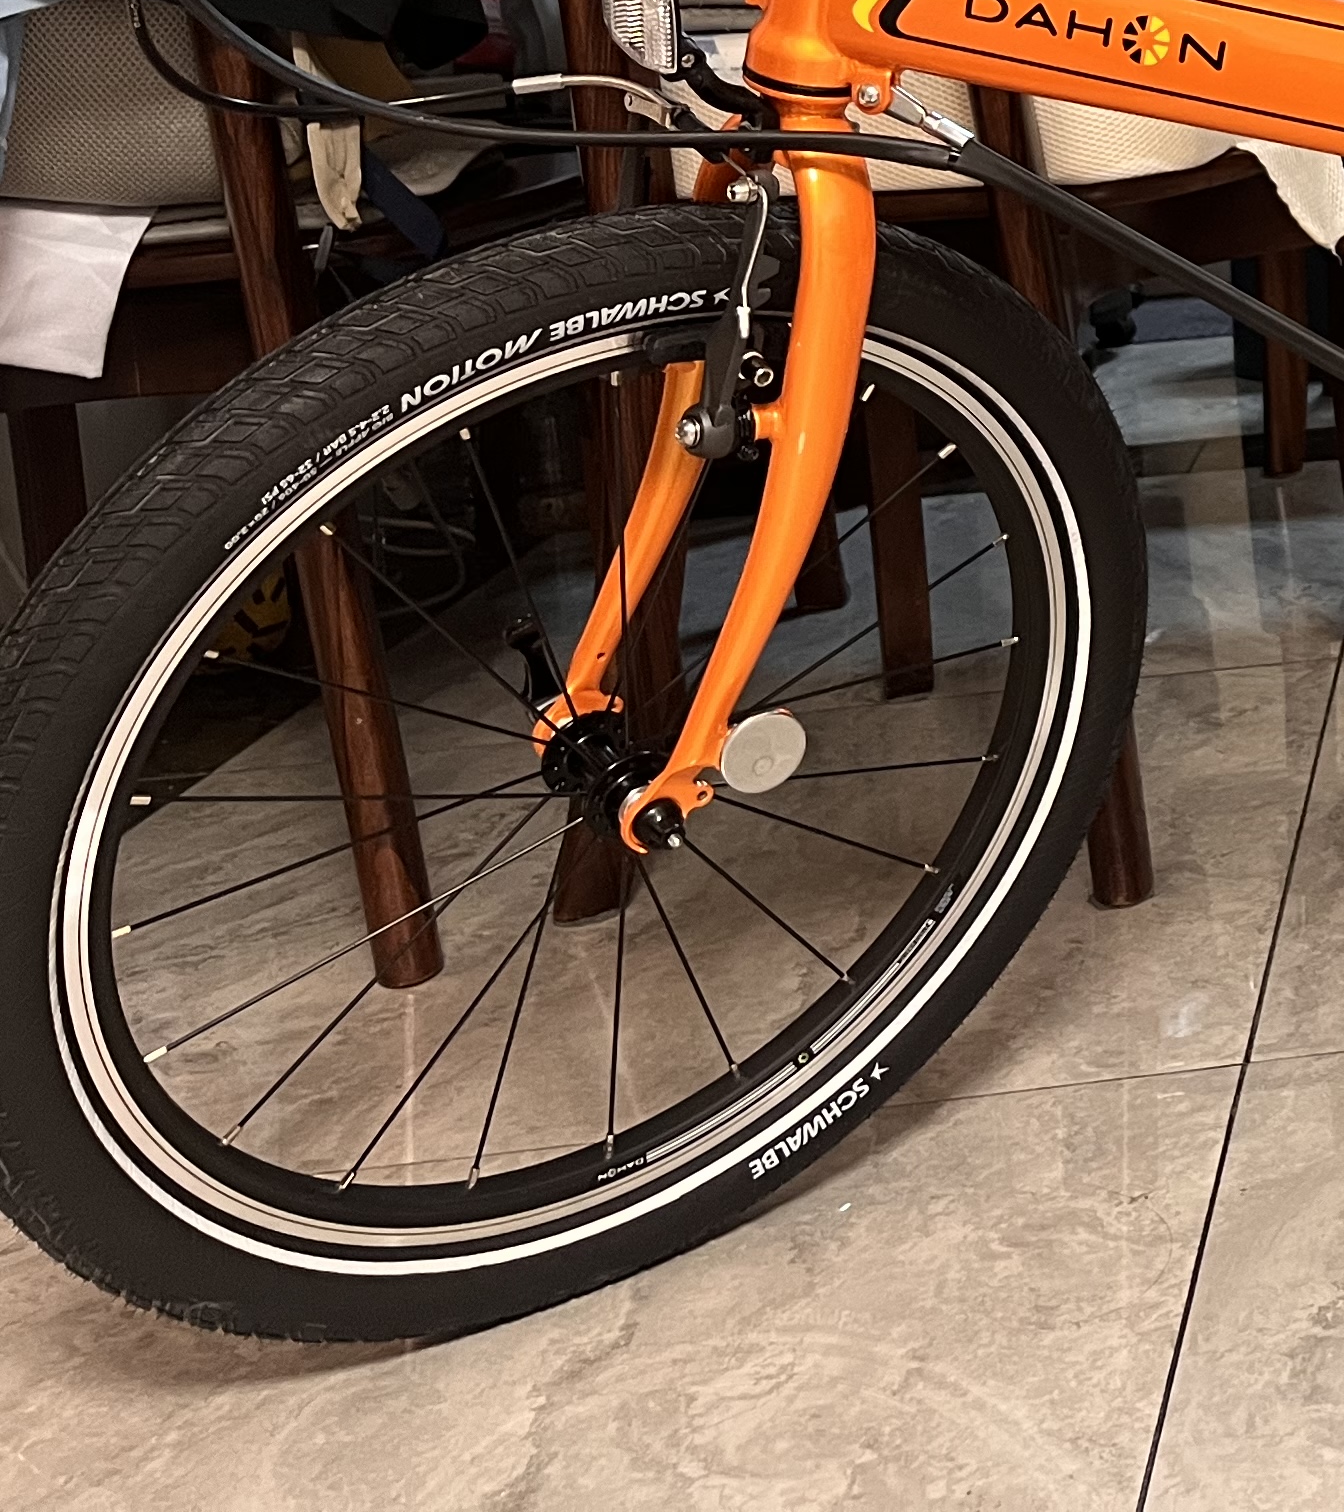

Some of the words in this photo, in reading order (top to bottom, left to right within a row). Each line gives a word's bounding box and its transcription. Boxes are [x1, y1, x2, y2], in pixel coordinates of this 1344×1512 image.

[549, 290, 707, 341] SCHWALBE
[401, 328, 543, 413] MOTION
[748, 1077, 870, 1180] SCHWALBE
